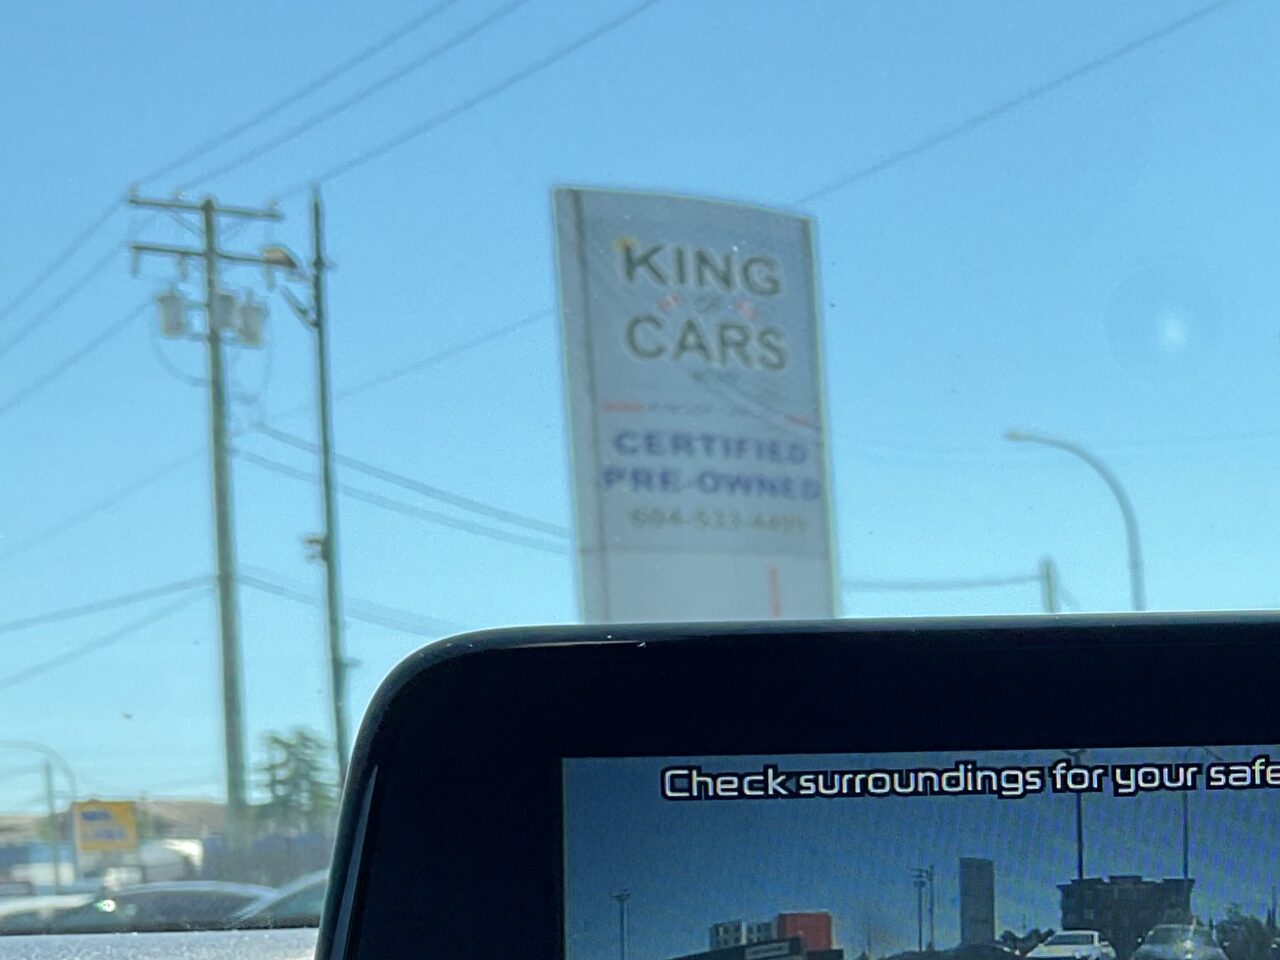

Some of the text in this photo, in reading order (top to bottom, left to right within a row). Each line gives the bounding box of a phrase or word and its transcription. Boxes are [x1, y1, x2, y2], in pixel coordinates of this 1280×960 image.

[621, 243, 781, 297] KING
[625, 314, 788, 371] CARS
[612, 430, 809, 464] CERTIFIED
[601, 466, 821, 501] PRE-OWNED
[663, 767, 789, 797] Check
[798, 764, 1042, 796] surroundings
[1052, 761, 1104, 789] for
[1115, 767, 1199, 793] your
